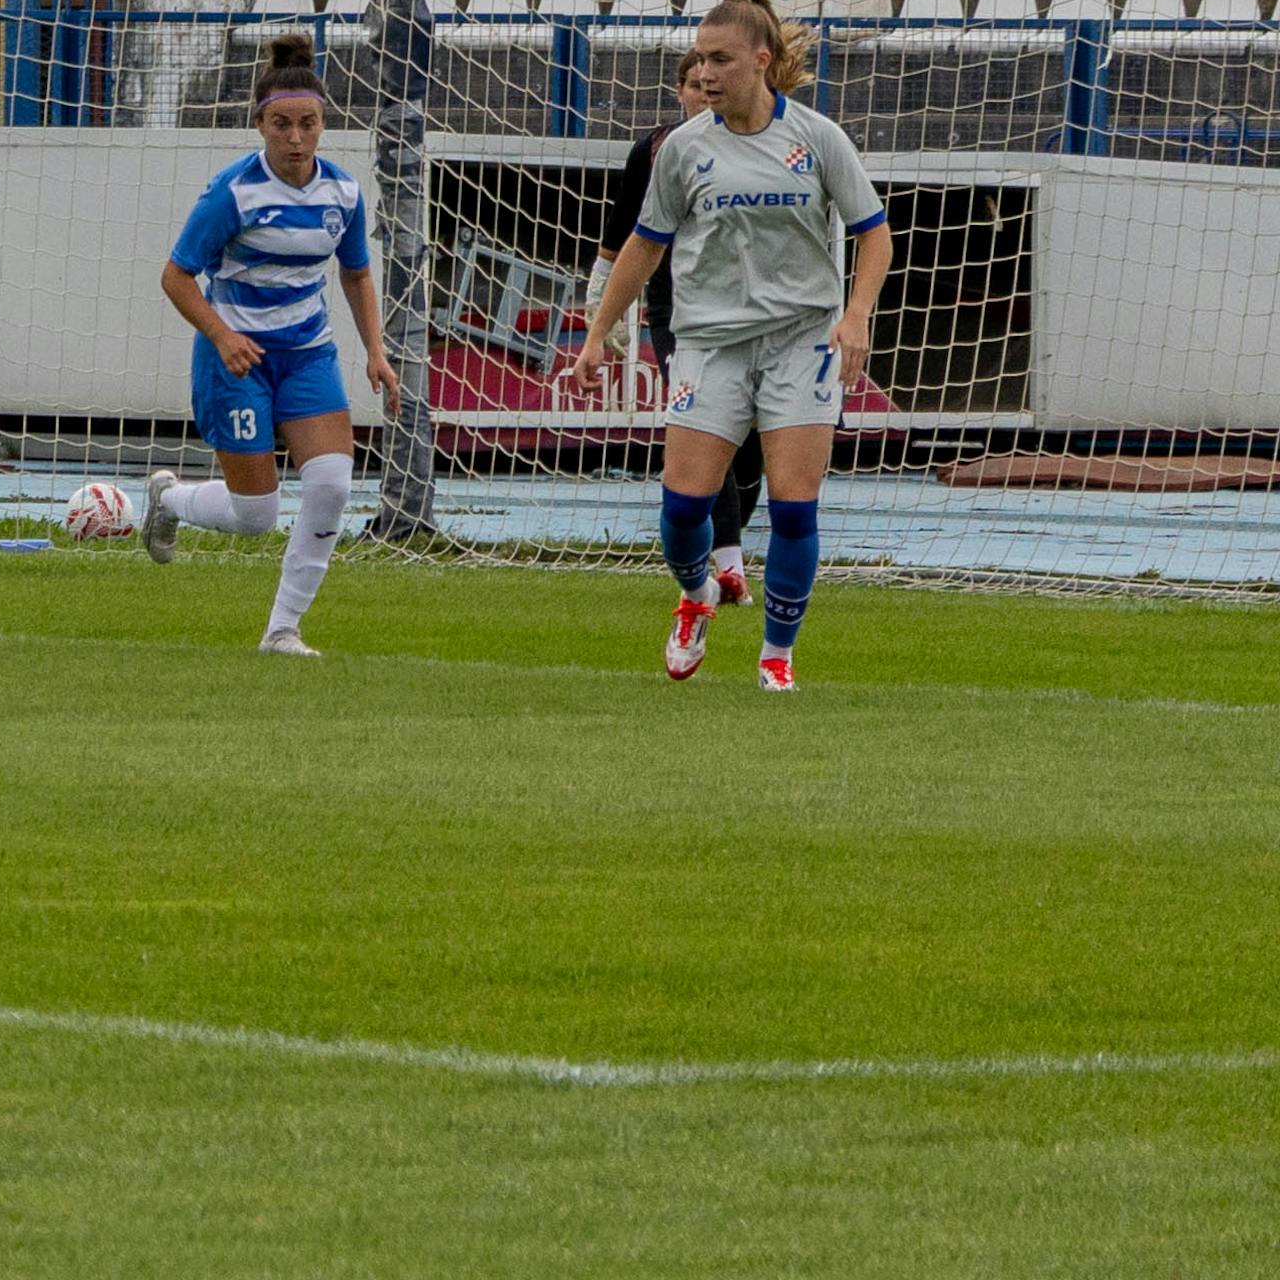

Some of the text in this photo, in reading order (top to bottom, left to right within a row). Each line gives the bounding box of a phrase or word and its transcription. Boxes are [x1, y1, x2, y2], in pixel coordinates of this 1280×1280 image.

[716, 193, 811, 209] FAVBET
[814, 344, 833, 384] 7
[228, 408, 257, 440] 13
